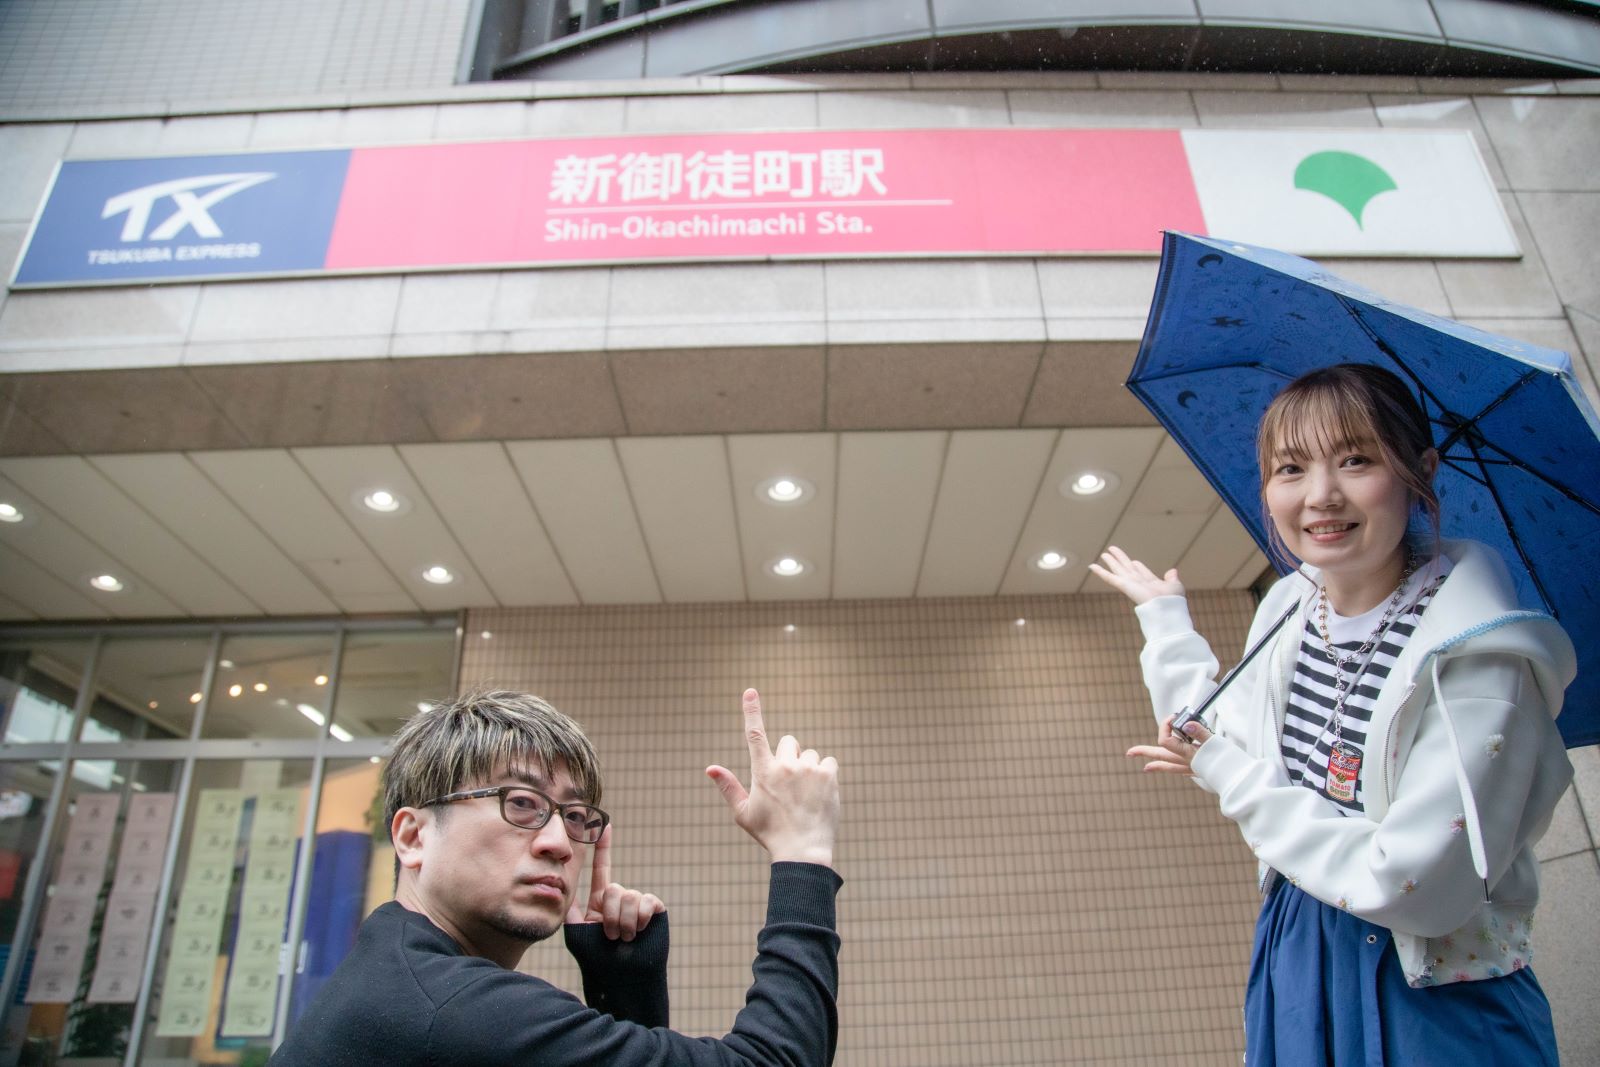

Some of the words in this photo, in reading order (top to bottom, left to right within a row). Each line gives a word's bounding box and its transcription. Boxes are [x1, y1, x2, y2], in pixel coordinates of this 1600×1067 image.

[548, 149, 887, 204] 新御徒町駅
[102, 172, 278, 242] TX
[545, 213, 805, 242] Shin-Okachimachi
[816, 212, 873, 234] Sta.
[88, 247, 172, 265] TSUKUBA
[176, 243, 261, 261] EXPRESS
